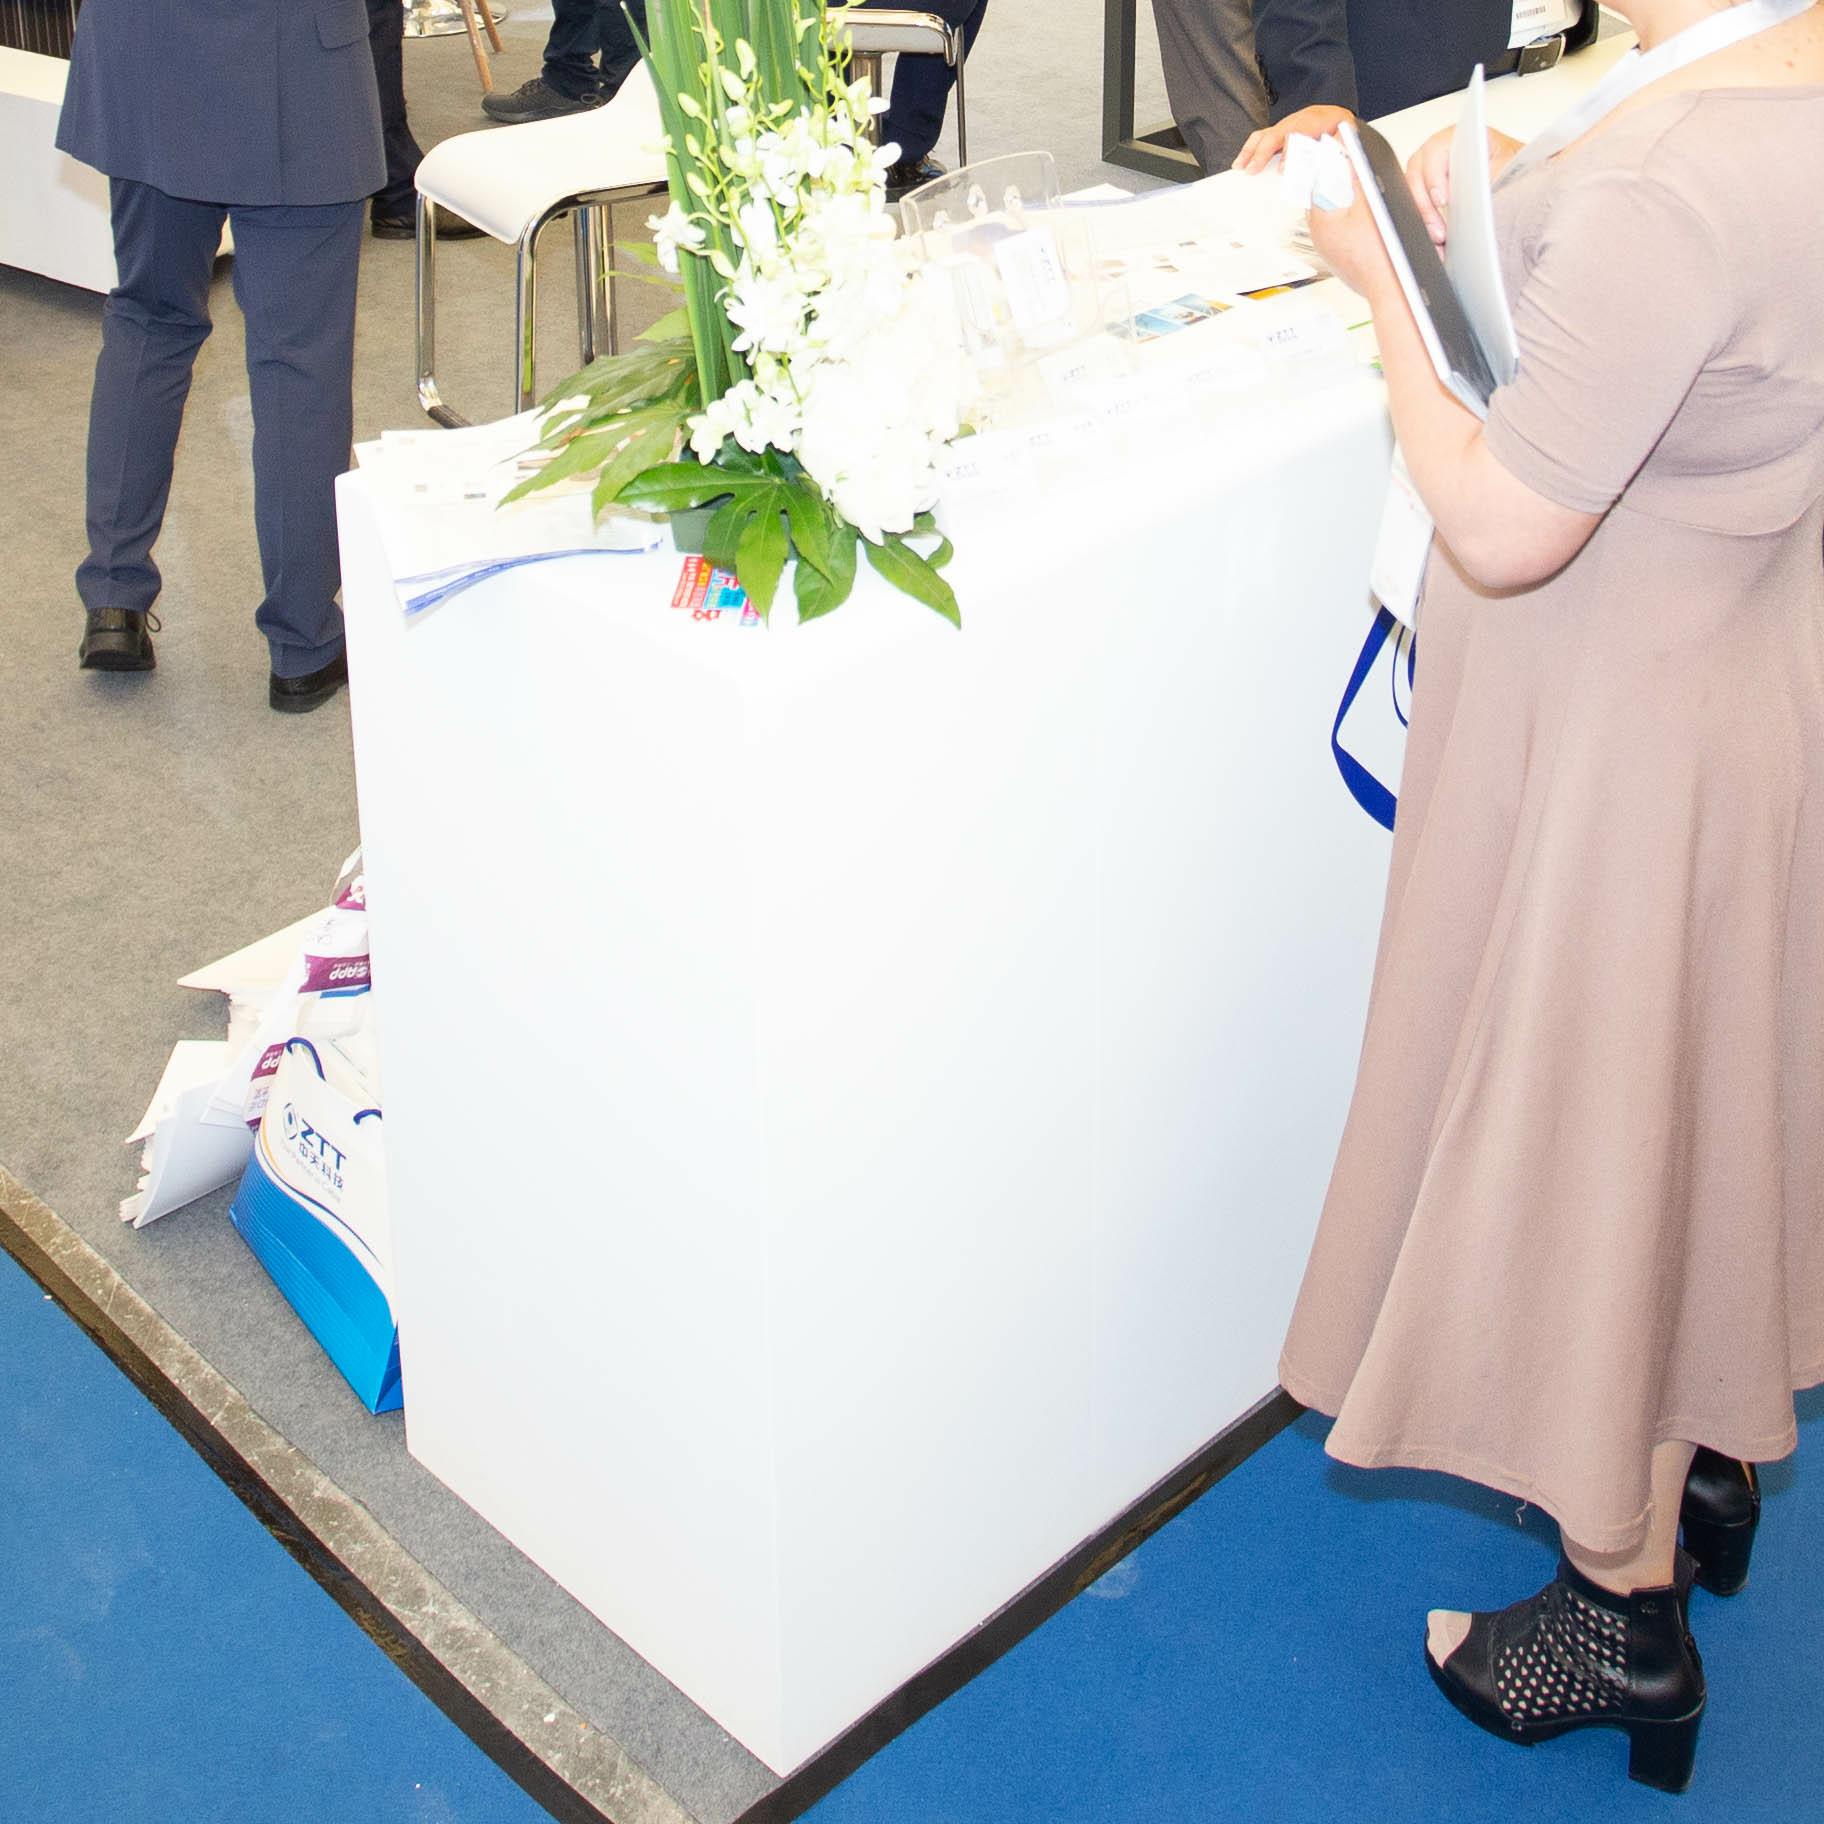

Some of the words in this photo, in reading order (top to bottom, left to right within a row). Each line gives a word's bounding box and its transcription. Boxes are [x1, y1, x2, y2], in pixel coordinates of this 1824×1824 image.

[298, 1142, 344, 1189] 中天科技
[301, 1117, 347, 1171] ZTT
